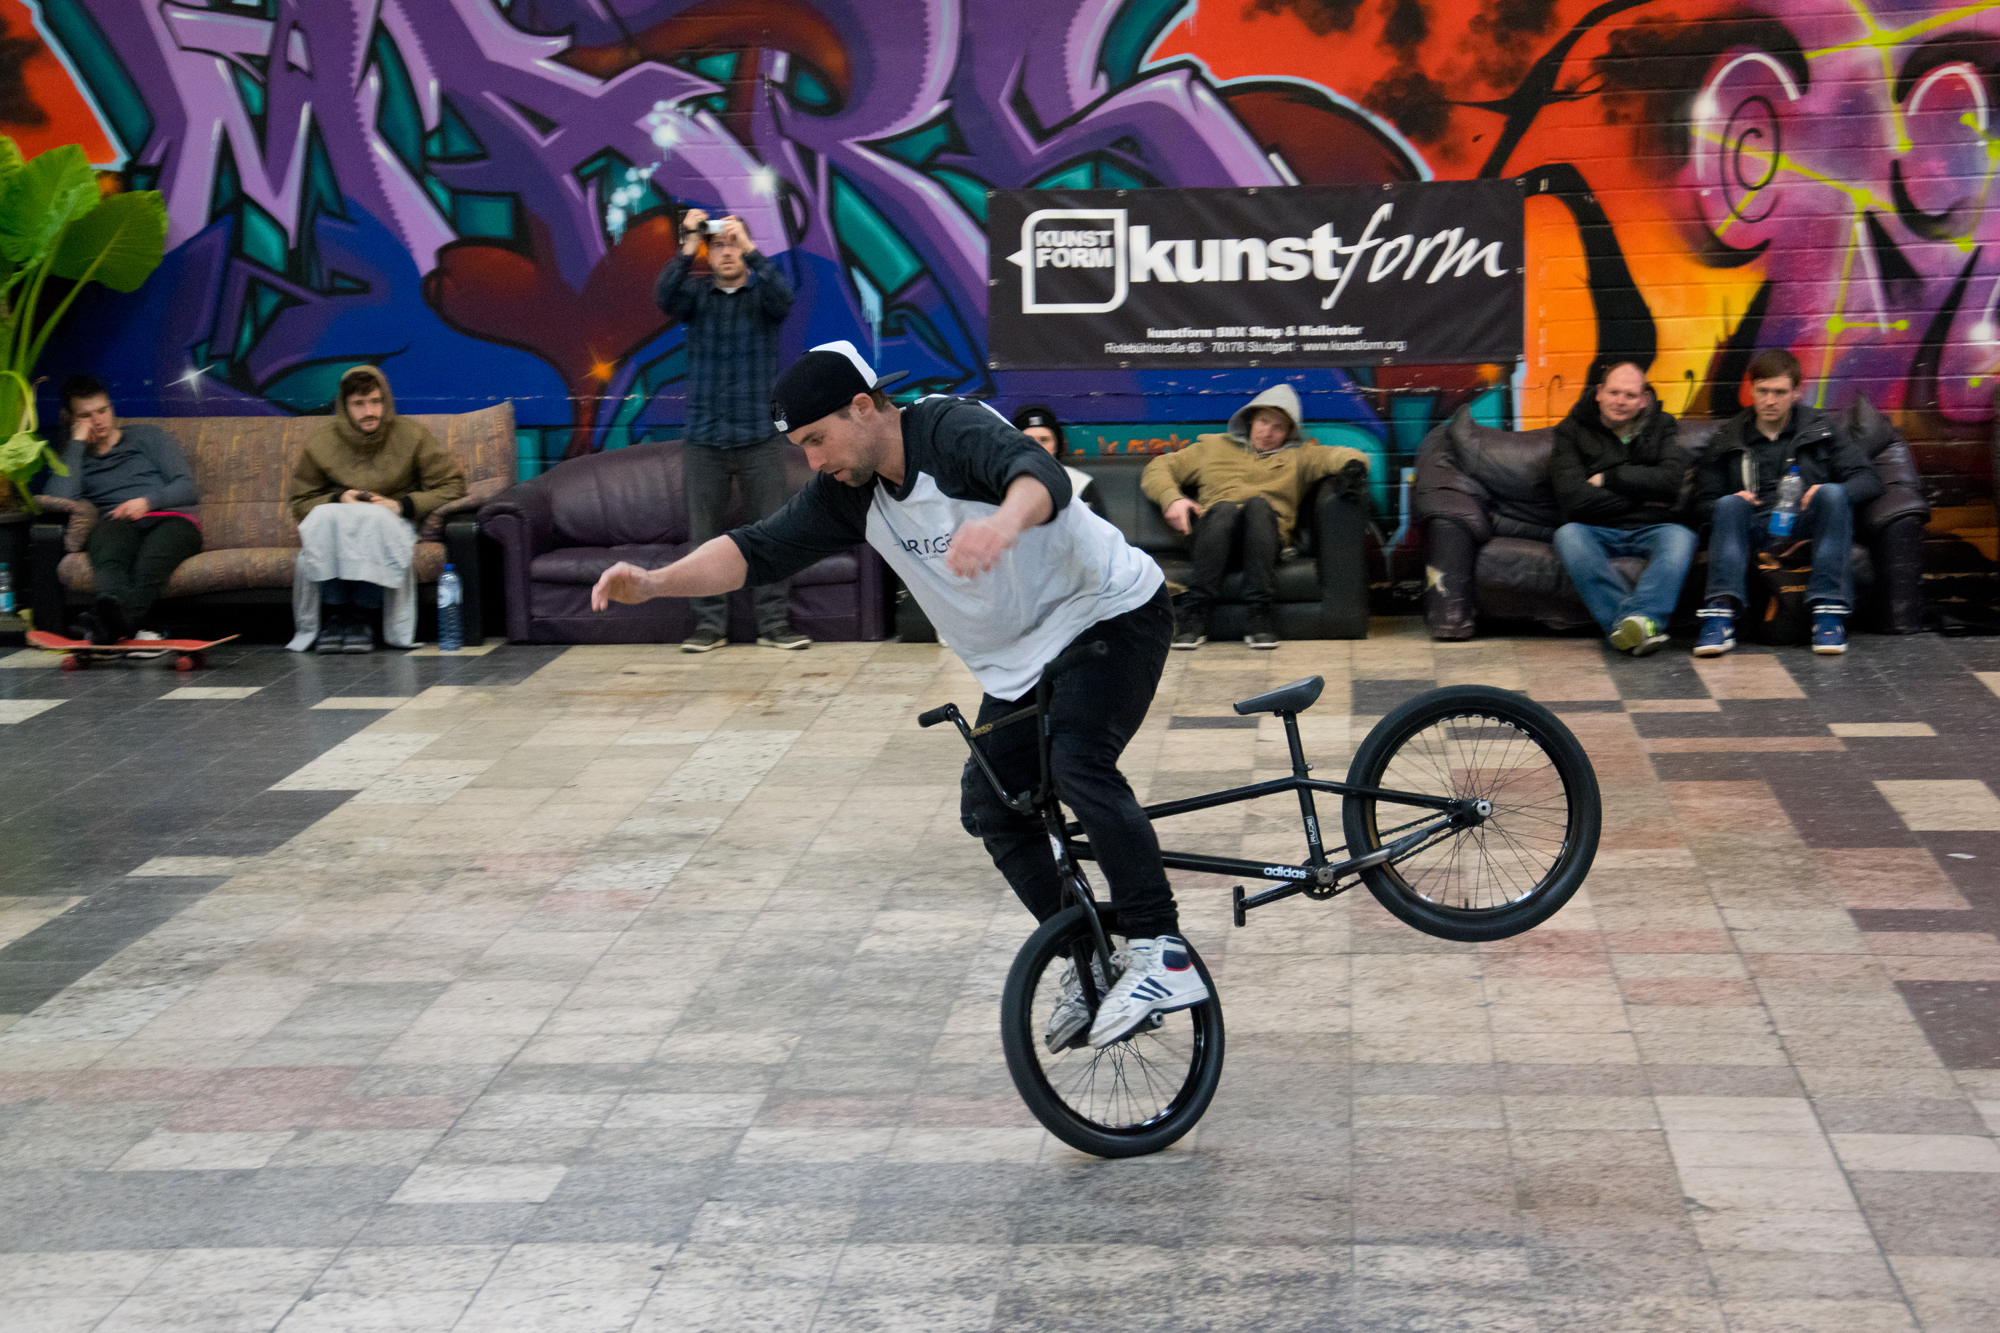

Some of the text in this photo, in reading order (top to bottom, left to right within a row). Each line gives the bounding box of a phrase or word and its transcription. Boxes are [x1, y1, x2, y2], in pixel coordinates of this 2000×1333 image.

[1035, 230, 1114, 247] KUNST
[1035, 247, 1115, 268] FORM
[1146, 325, 1364, 338] kunstform BMX Shop & Mailorder
[1211, 341, 1247, 353] 70178
[1247, 341, 1296, 354] Stuttgart
[1302, 339, 1407, 352] www.kunstform.org
[1263, 866, 1307, 879] adidas
